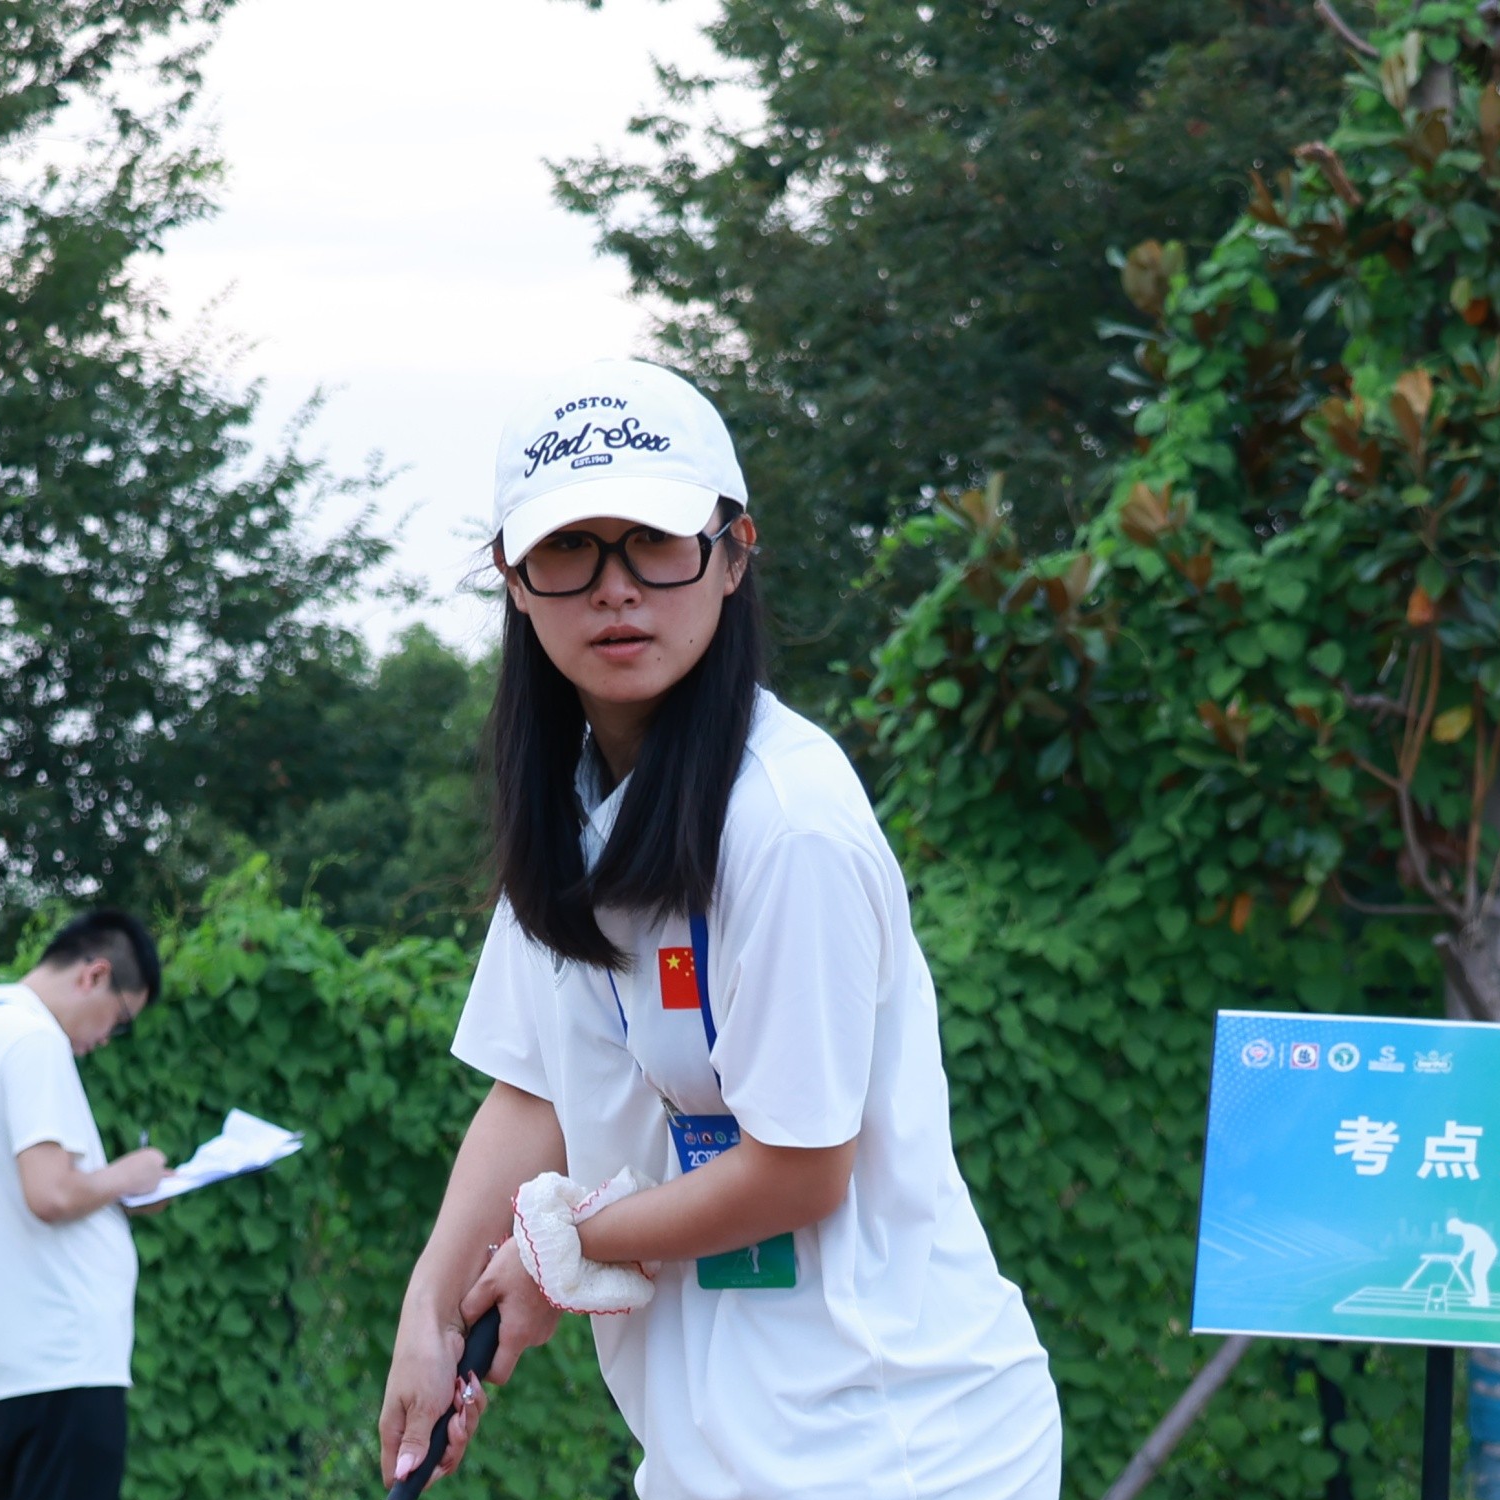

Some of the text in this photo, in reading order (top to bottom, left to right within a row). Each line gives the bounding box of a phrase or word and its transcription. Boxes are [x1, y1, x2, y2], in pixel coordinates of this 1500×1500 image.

[554, 396, 628, 421] BOSTON
[524, 417, 671, 478] Red Sox
[573, 454, 609, 468] EST.1901
